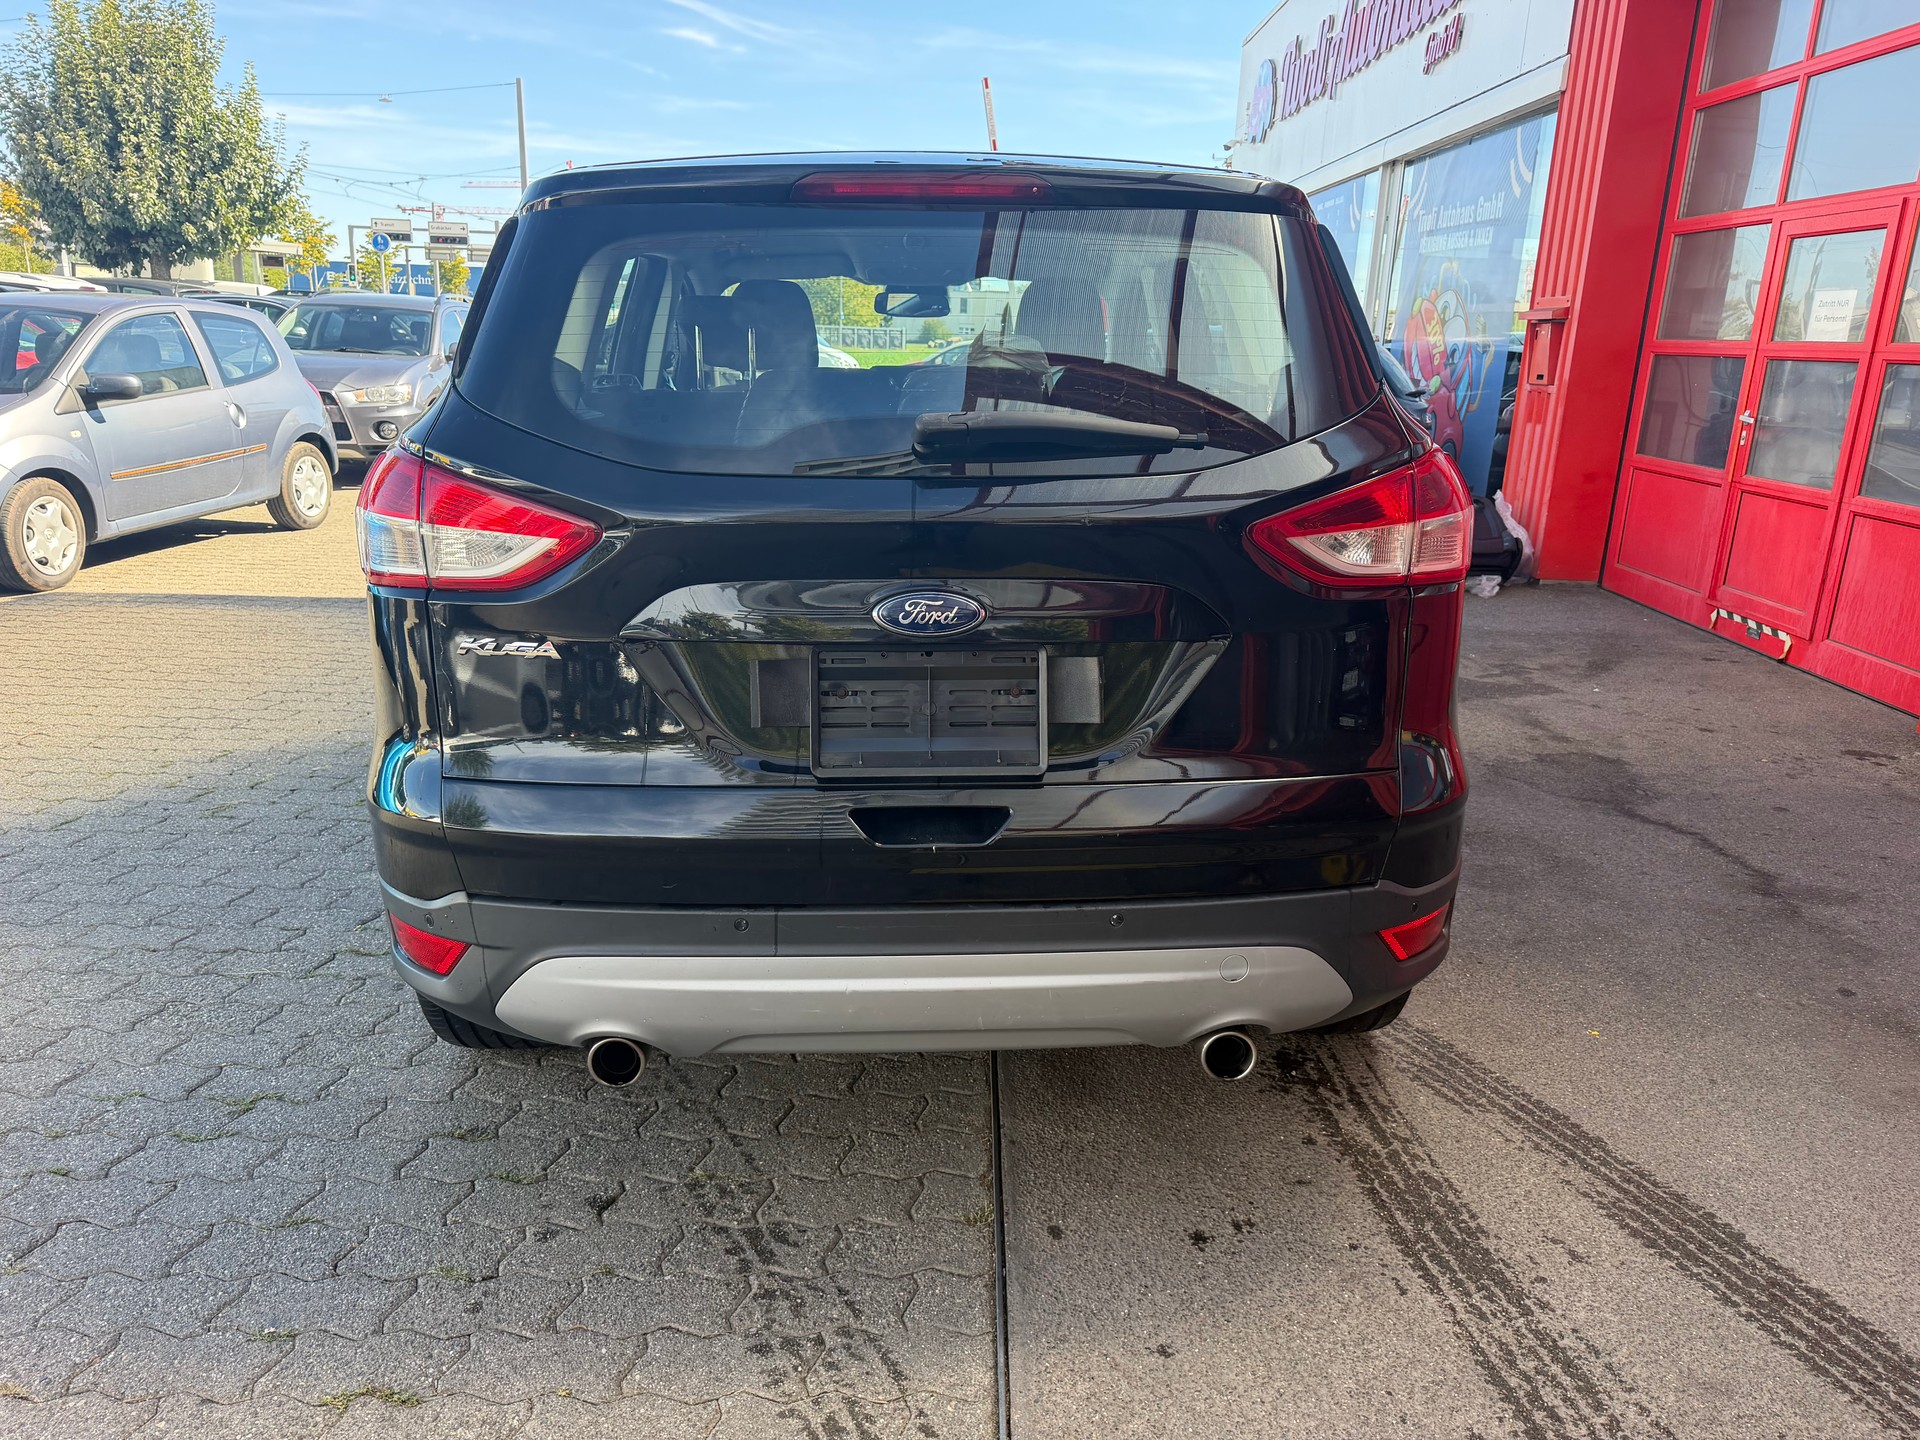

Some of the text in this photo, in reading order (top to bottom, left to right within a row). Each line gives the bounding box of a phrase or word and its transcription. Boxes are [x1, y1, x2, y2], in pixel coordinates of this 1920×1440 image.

[1437, 202, 1475, 229] Autohaus
[1476, 192, 1505, 222] GmbH
[1837, 299, 1849, 308] NUR
[899, 599, 958, 625] Ford
[457, 638, 562, 660] KUGA
